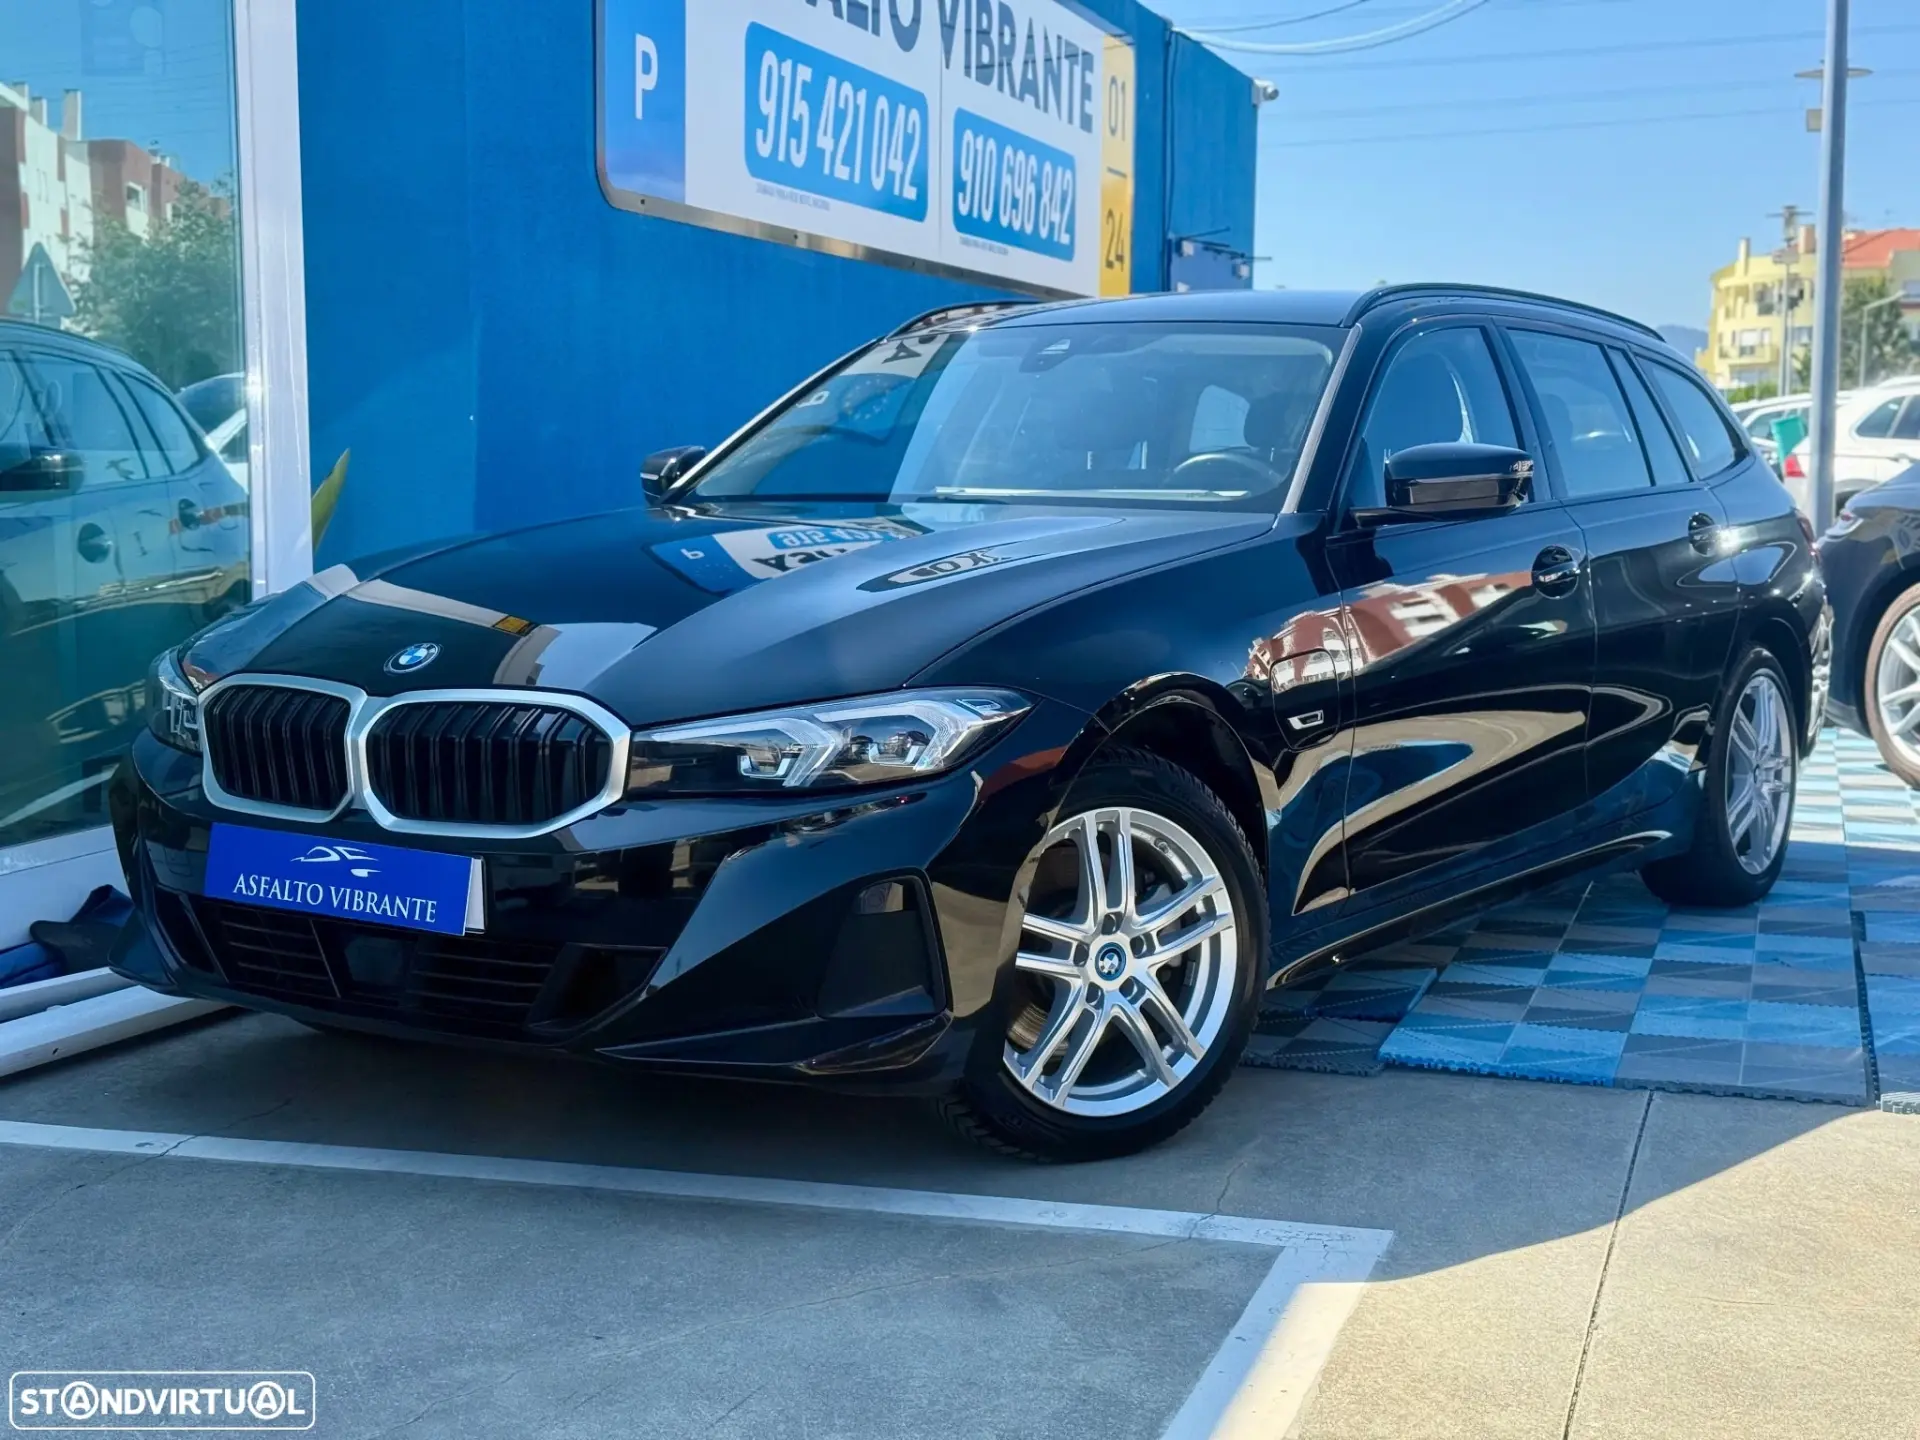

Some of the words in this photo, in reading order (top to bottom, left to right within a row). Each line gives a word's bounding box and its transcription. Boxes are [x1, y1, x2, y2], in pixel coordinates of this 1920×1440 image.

[635, 32, 658, 120] P
[937, 0, 1094, 134] VIBRANTE
[1108, 75, 1126, 142] 01
[756, 49, 812, 168] 915
[816, 75, 867, 184] 421
[870, 94, 921, 201] 042
[957, 128, 997, 223] 910
[1000, 144, 1037, 236] 696
[1039, 160, 1073, 246] 842
[1105, 208, 1125, 272] 24
[233, 873, 323, 905] ASFALTO
[330, 886, 437, 923] VIBRANTE
